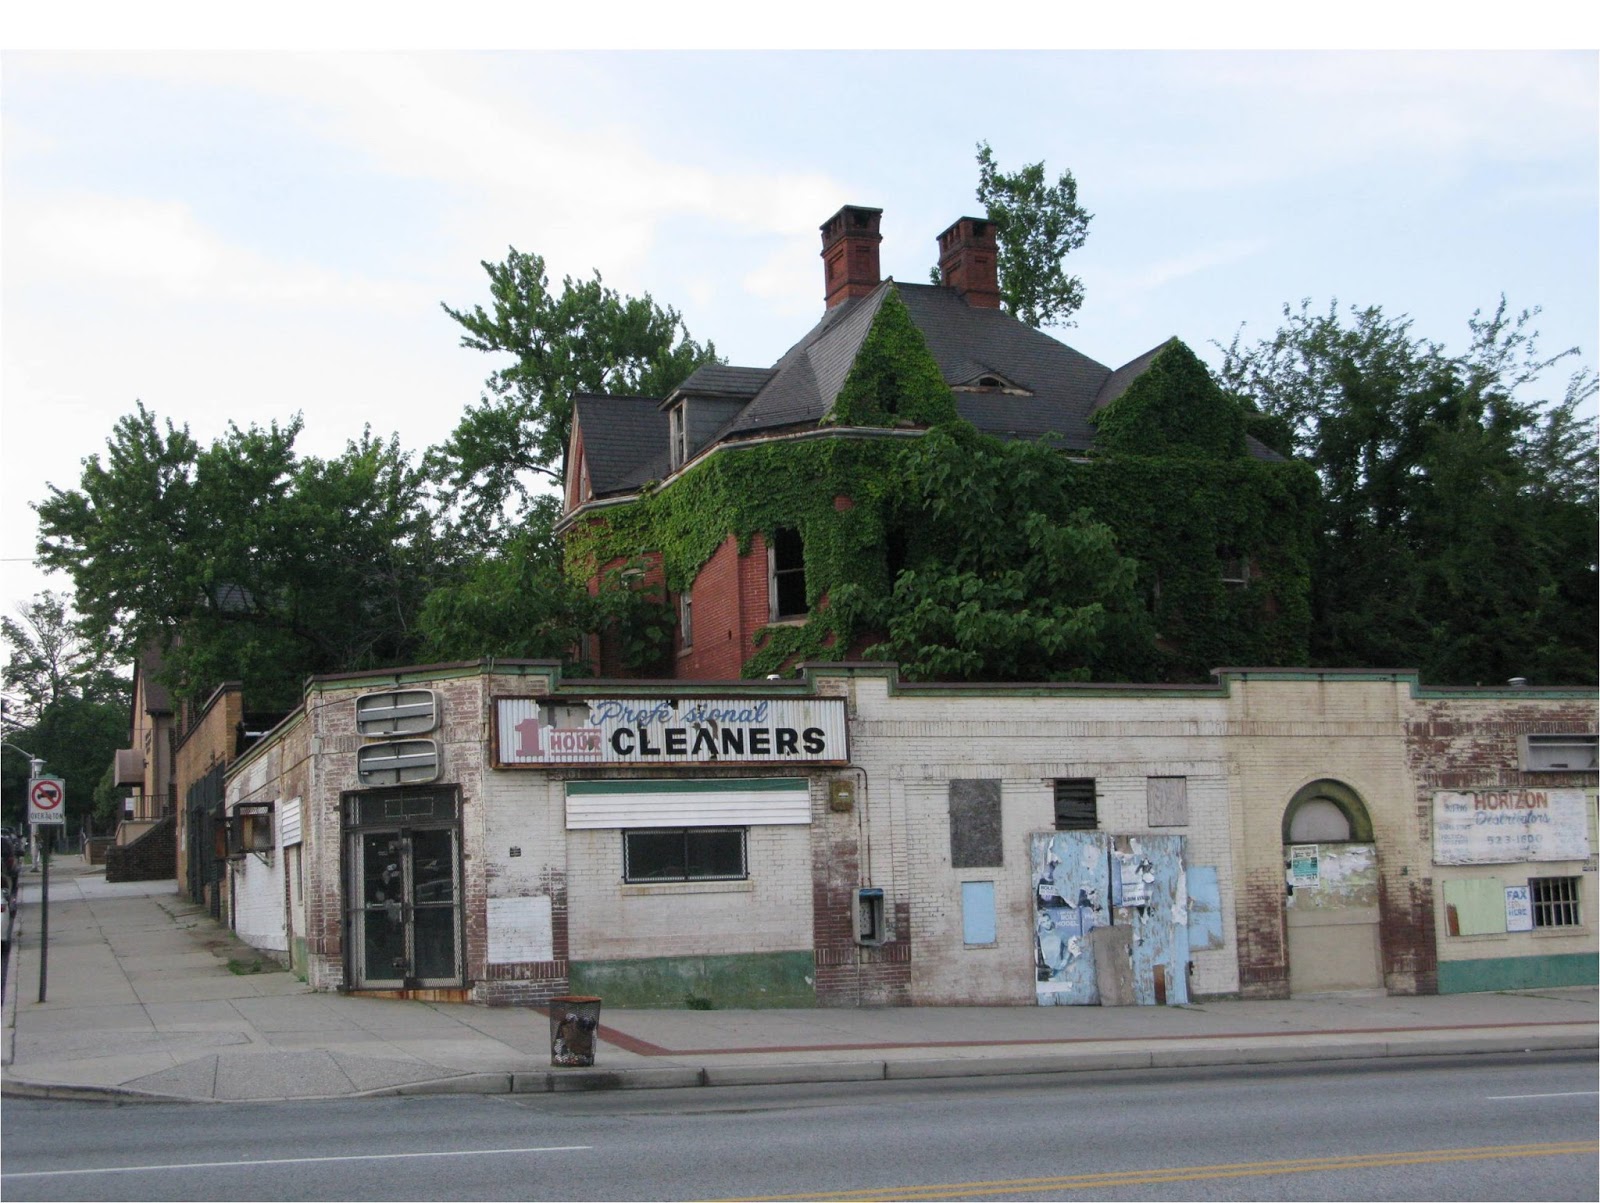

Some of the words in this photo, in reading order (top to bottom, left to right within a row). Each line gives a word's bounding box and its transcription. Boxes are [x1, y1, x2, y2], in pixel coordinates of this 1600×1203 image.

[590, 701, 769, 726] Profesional
[515, 719, 545, 757] 1
[611, 727, 826, 757] CLEANERS
[1474, 791, 1548, 811] HORIZON
[1506, 888, 1528, 901] FAX
